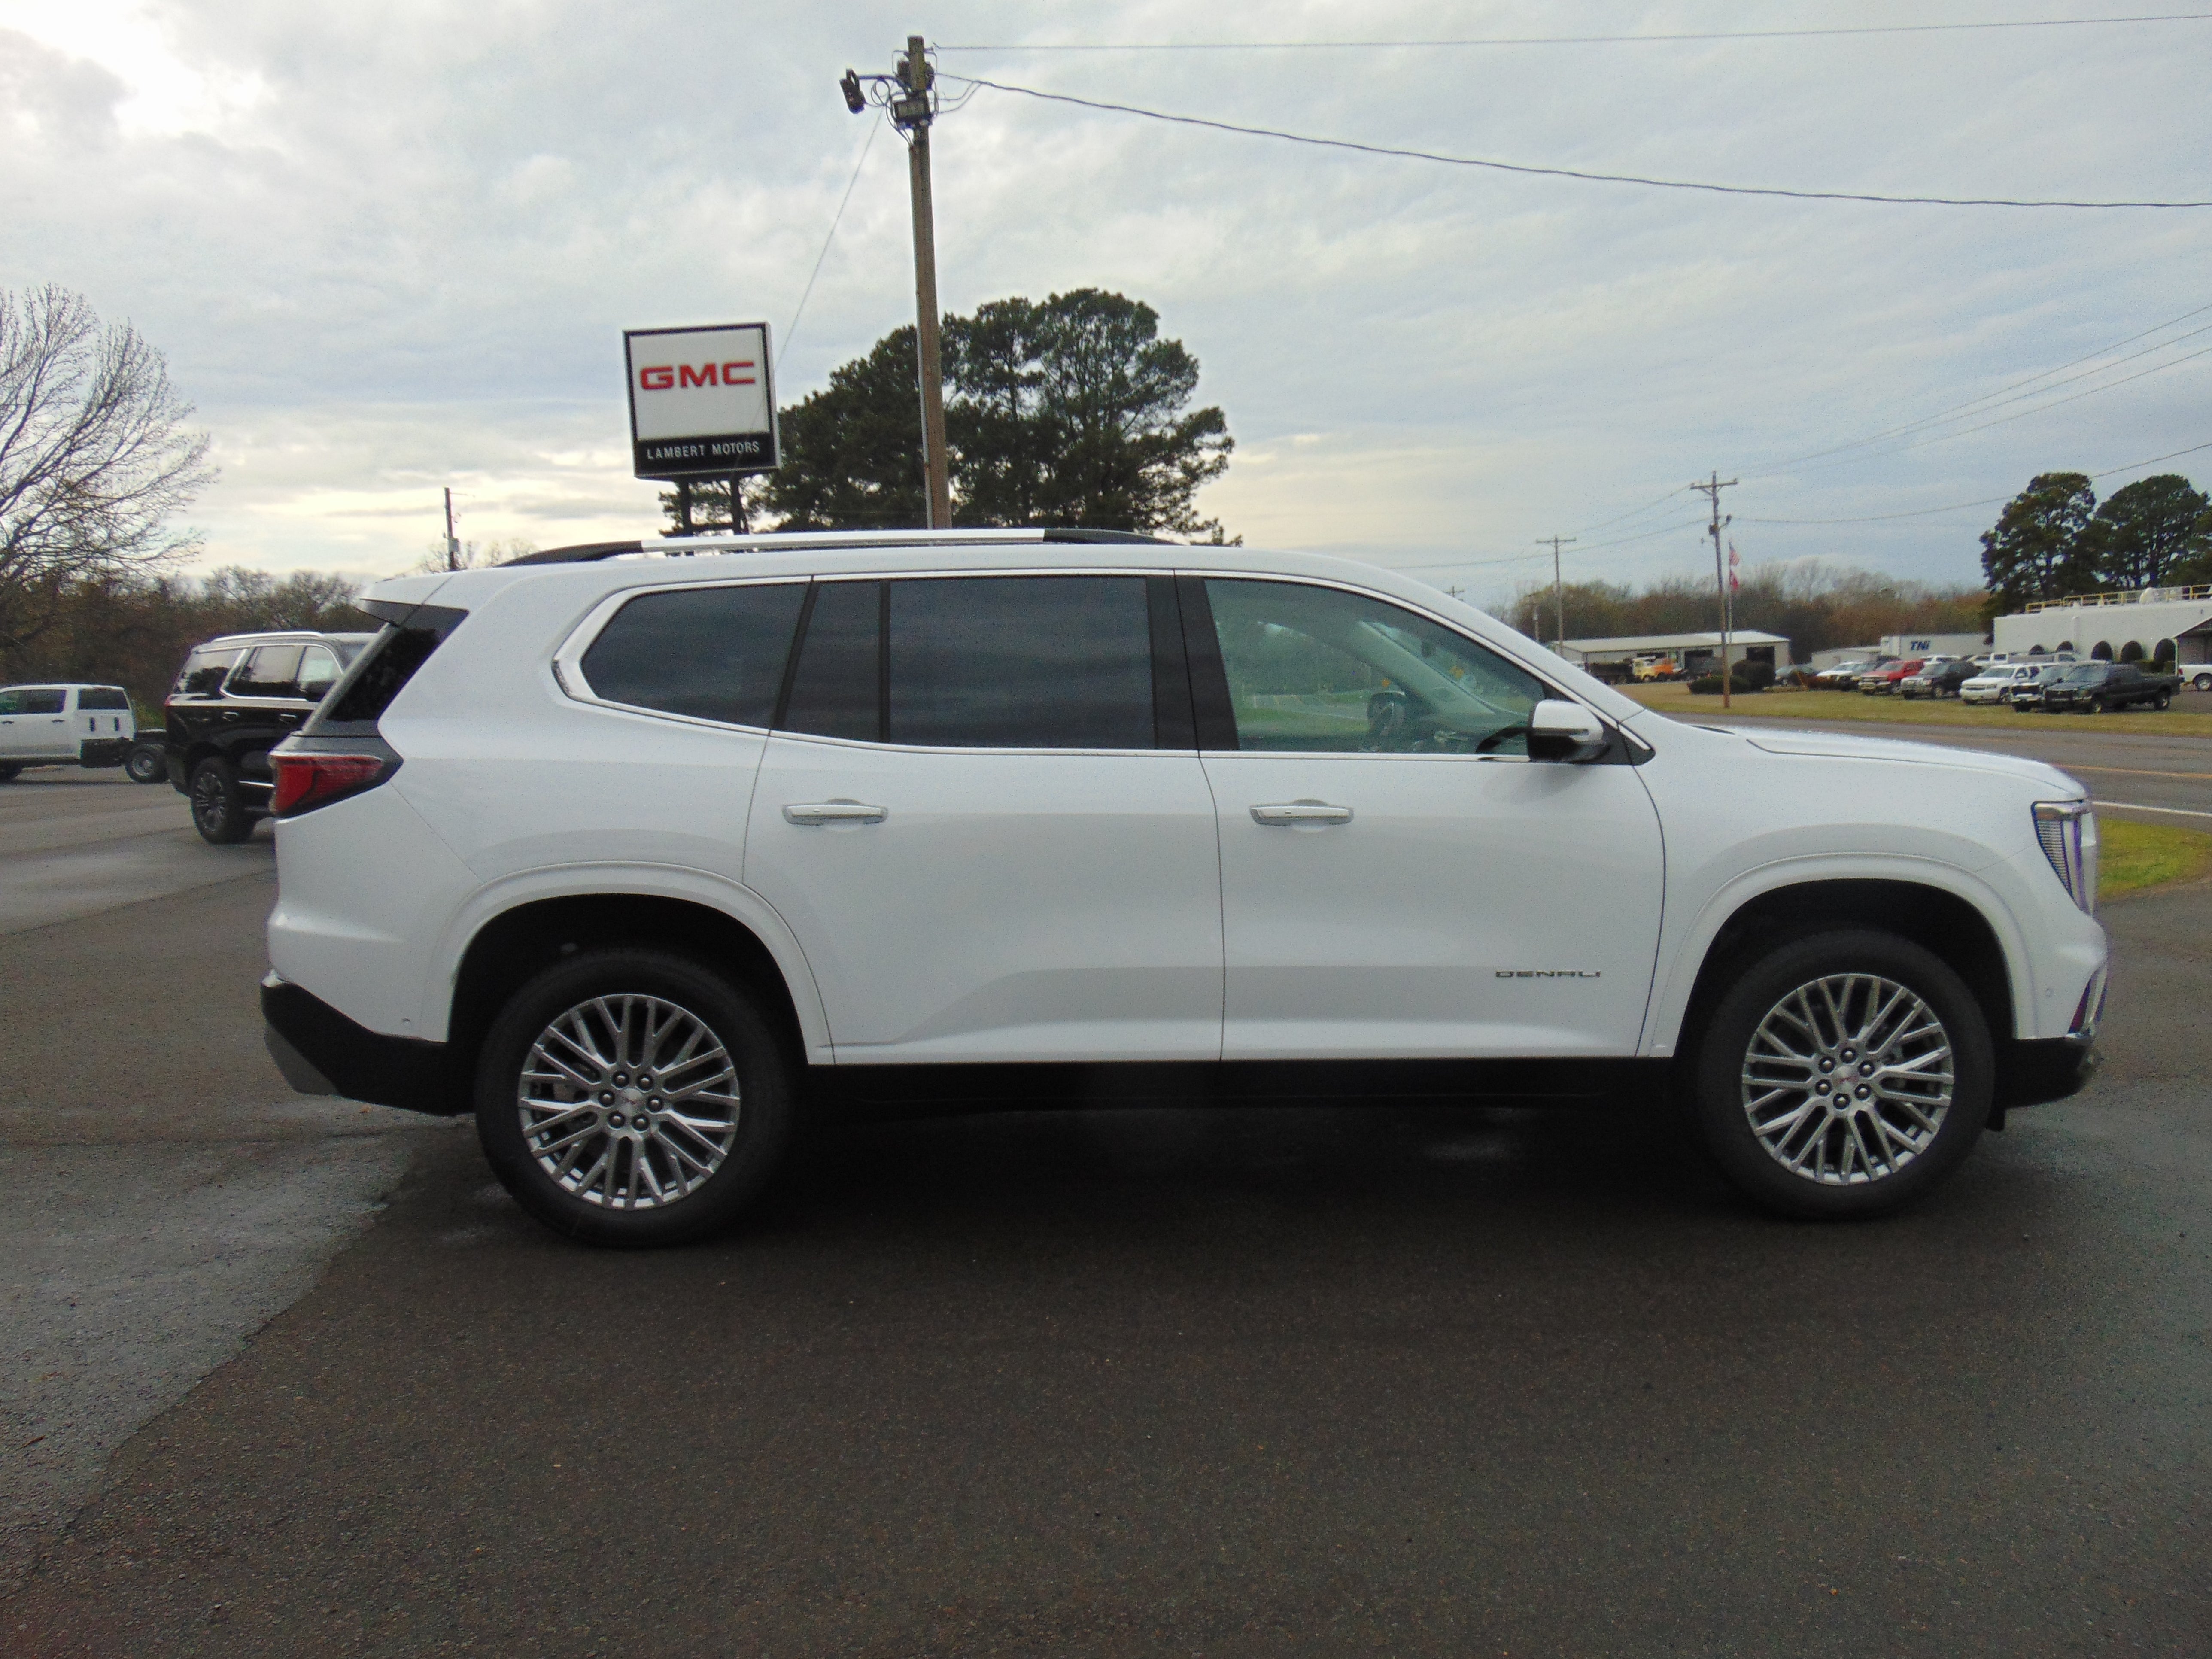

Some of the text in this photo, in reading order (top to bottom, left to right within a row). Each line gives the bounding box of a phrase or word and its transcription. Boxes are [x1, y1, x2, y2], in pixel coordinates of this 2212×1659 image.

[640, 361, 756, 390] GMC
[646, 441, 760, 460] LAMBERT MOTORS
